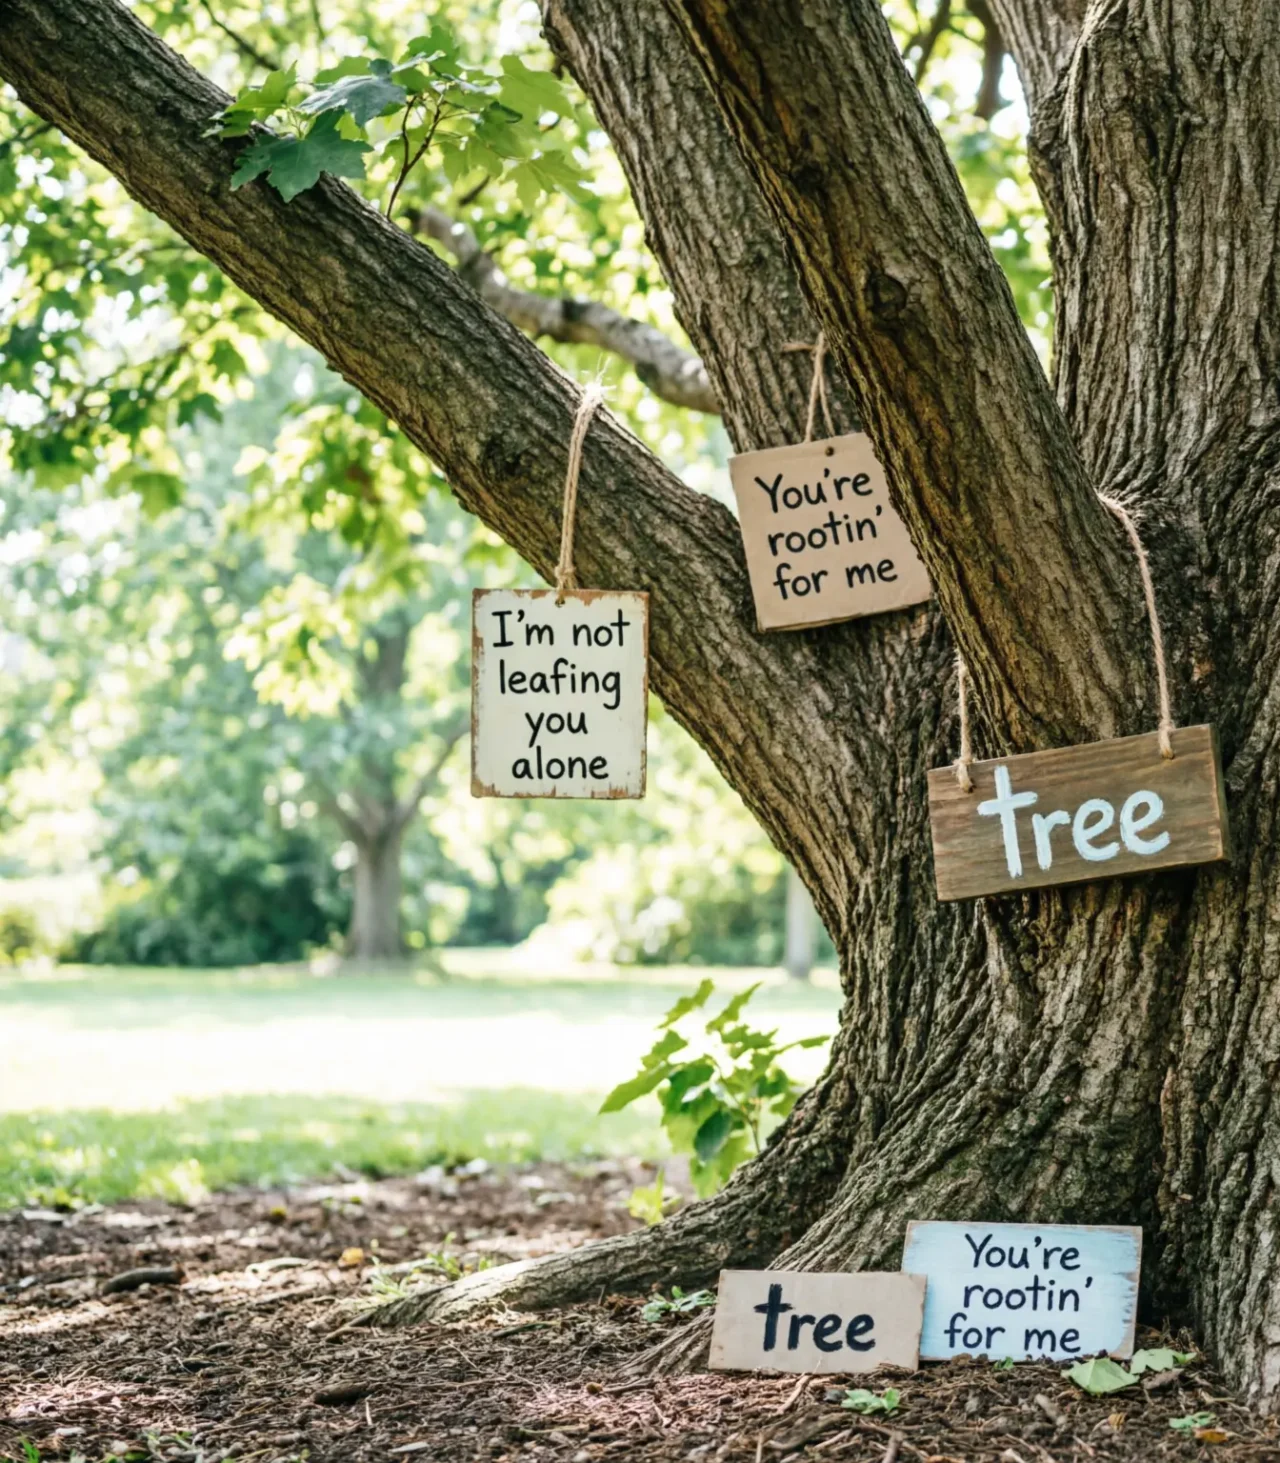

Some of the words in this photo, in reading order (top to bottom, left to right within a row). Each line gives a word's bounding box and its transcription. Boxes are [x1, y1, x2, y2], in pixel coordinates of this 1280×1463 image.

[754, 468, 872, 513] You're
[768, 505, 882, 556] rootin'
[773, 563, 828, 600] for
[846, 559, 897, 588] me
[492, 610, 554, 647] I'm
[573, 609, 630, 646] not
[500, 658, 620, 710] leafing
[525, 712, 588, 748] you
[512, 746, 608, 779] alone
[977, 766, 1169, 877] tree
[965, 1234, 1080, 1270] You're
[964, 1275, 1092, 1311] rootin'
[754, 1284, 875, 1352] tree
[944, 1313, 1005, 1349] for
[1024, 1324, 1081, 1353] me
